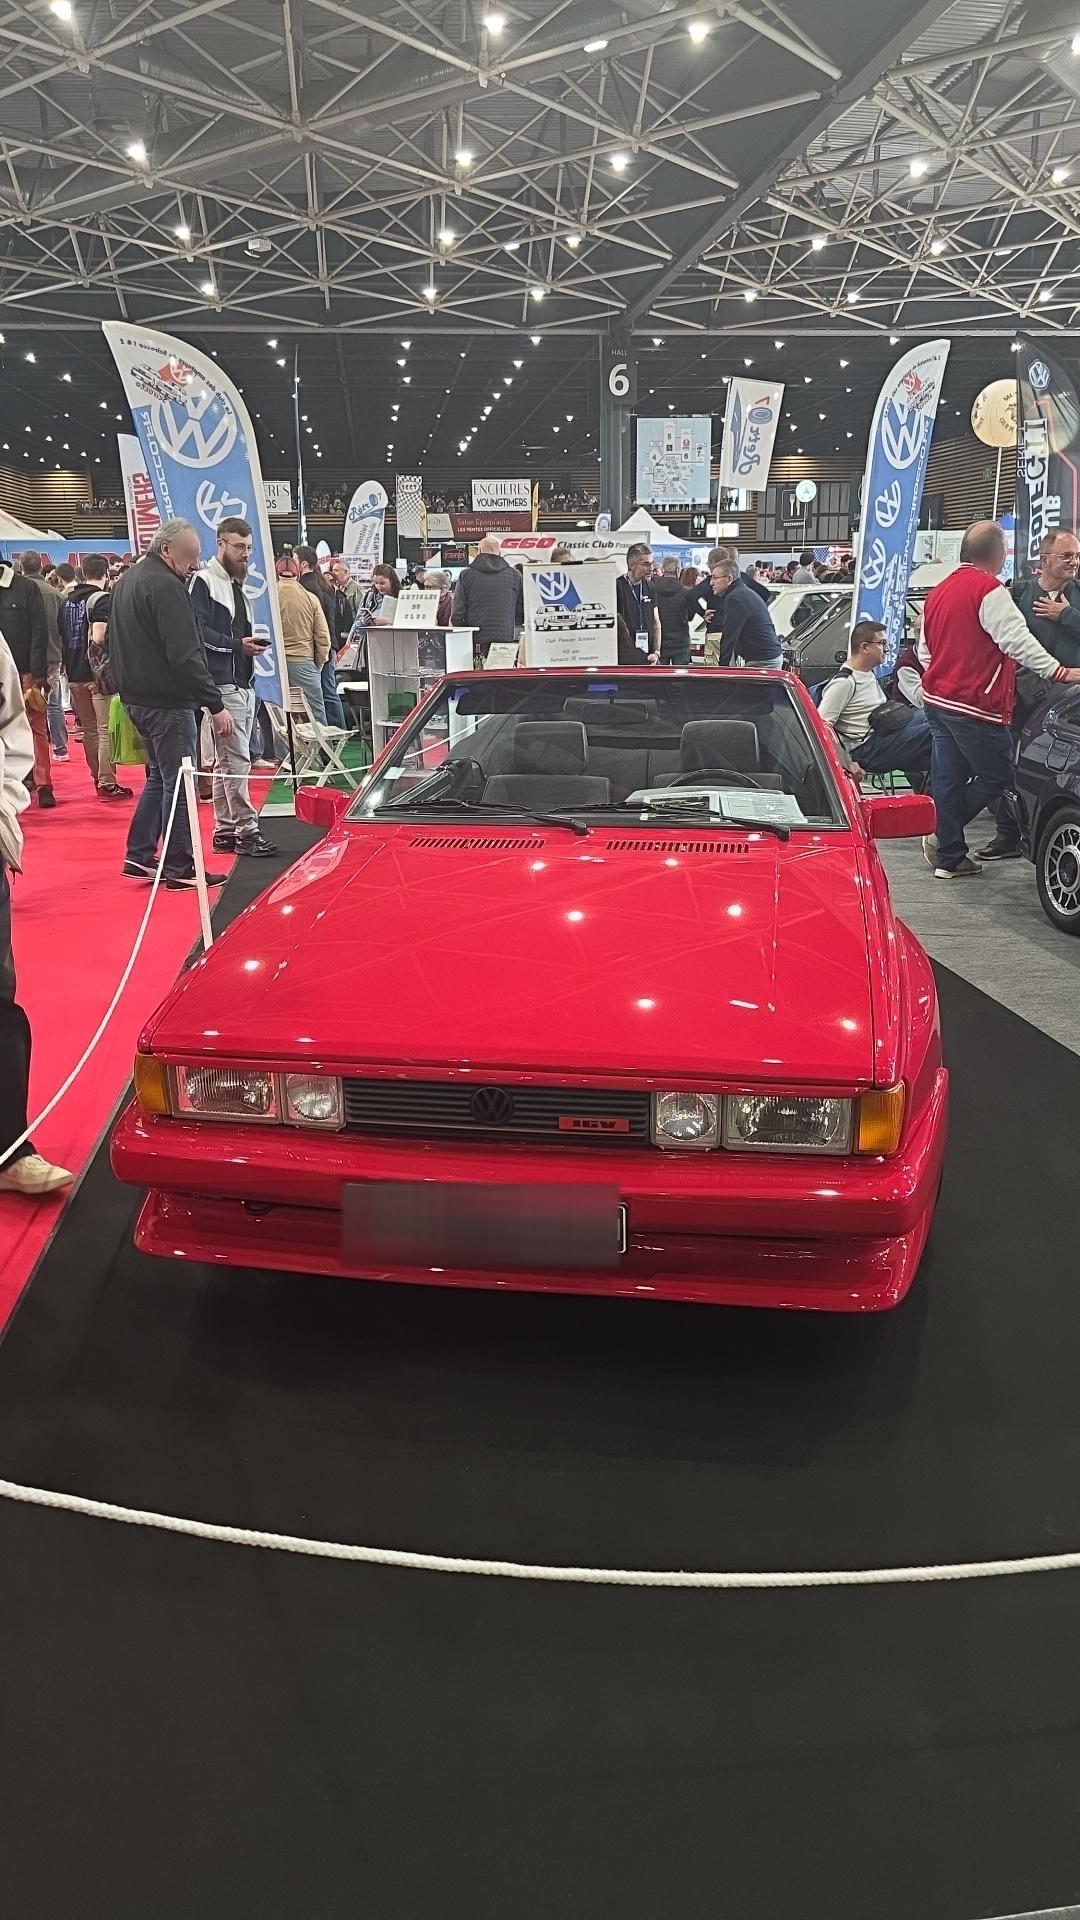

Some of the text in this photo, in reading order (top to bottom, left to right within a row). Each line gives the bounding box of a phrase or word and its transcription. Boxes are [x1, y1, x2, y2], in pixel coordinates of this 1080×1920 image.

[609, 363, 630, 396] 6
[476, 497, 528, 507] YOUNGTIMERS
[458, 518, 475, 526] Salon
[500, 537, 556, 549] G60
[557, 540, 590, 549] Classic
[592, 540, 614, 549] Club
[571, 1120, 617, 1129] 16V
